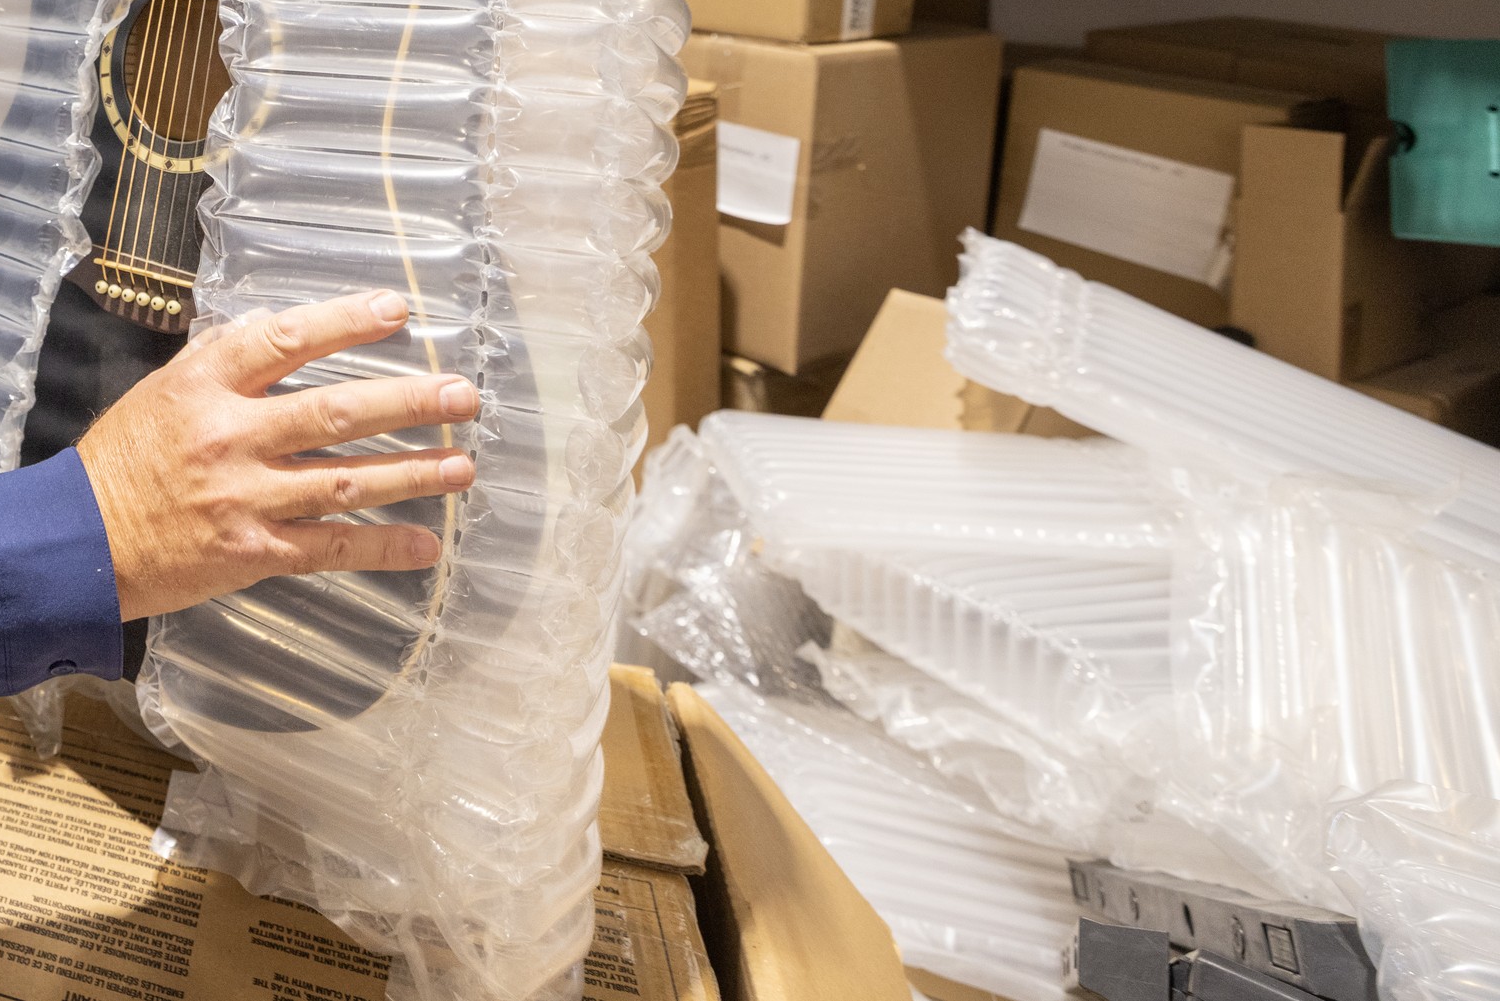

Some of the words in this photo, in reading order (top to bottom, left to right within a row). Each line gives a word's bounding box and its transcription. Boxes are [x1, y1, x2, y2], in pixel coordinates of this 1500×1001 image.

[28, 866, 38, 874] LE
[39, 868, 71, 883] APPELEZ
[17, 872, 32, 882] LES
[32, 876, 44, 885] OU
[44, 879, 68, 892] PERTE
[68, 886, 80, 895] LA
[79, 889, 89, 897] SI
[113, 888, 128, 899] ÉTÉ
[129, 893, 142, 902] AIT
[8, 898, 53, 917] CONSERVER
[118, 900, 159, 916] DOMMAGE
[143, 897, 200, 917] MARCHANDISE
[34, 916, 44, 924] LE
[92, 912, 105, 921] DU
[159, 911, 171, 920] OU
[172, 914, 198, 927] PERTE
[44, 919, 62, 929] PAR
[257, 919, 285, 933] CLAIM
[14, 921, 78, 945] SOIGNEUSEMENT
[111, 927, 128, 938] QUE
[129, 932, 150, 944] TANT
[247, 925, 286, 943] WRITTEN
[294, 929, 311, 940] FILE
[79, 939, 95, 951] ÉTÉ
[100, 934, 116, 946] ÉTÉ
[116, 939, 123, 947] A
[150, 938, 163, 947] EN
[294, 939, 315, 951] WITH
[312, 934, 334, 946] THEN
[94, 944, 102, 952] A
[249, 936, 310, 959] MERCHANDISE
[316, 945, 351, 961] FOLLOW
[334, 940, 360, 954] DATE,
[36, 949, 57, 962] SONT
[58, 955, 73, 966] QUI
[102, 946, 162, 969] MARCHANDISE
[163, 952, 190, 965] TOUTE
[351, 955, 370, 966] AND
[588, 950, 618, 962] DAMA
[31, 959, 43, 969] CE
[43, 963, 55, 973] DE
[73, 960, 85, 969] ET
[162, 963, 189, 976] CETTE
[336, 960, 371, 976] APPEAR
[371, 960, 391, 972] LAIM
[583, 957, 616, 971] CARRIE
[55, 966, 94, 984] CONTENU
[617, 966, 637, 976] THE
[93, 977, 105, 987] LE
[251, 976, 270, 989] THE
[272, 972, 291, 984] THE
[290, 977, 315, 991] WITH
[584, 976, 603, 987] LOS
[609, 973, 638, 985] FULLY
[283, 986, 302, 998] YOU
[314, 985, 343, 1000] CLAIM
[605, 979, 640, 996] VISIBLE
